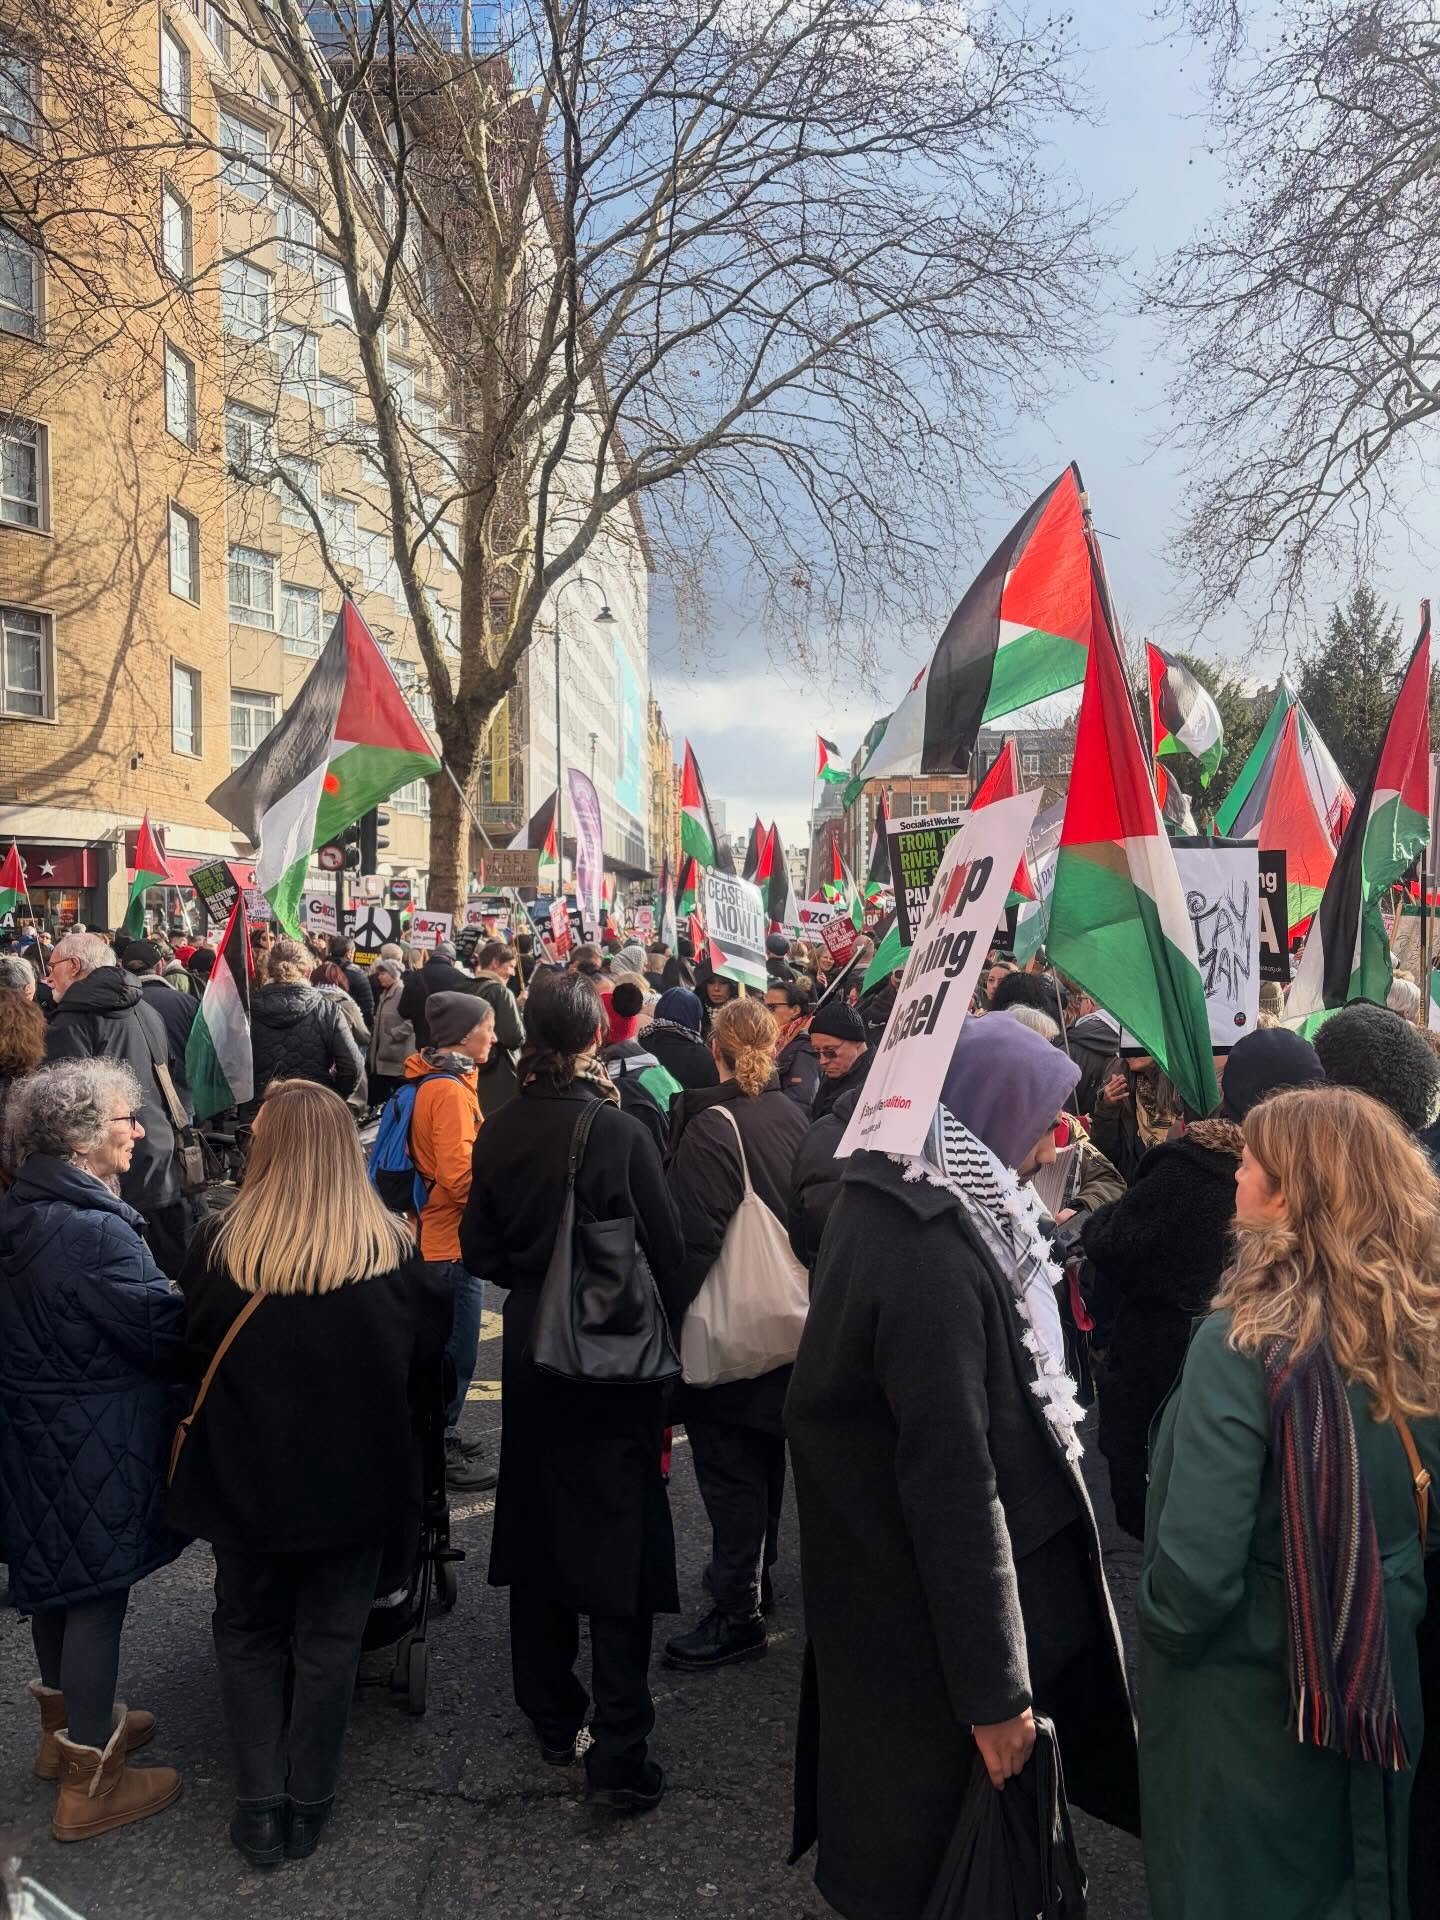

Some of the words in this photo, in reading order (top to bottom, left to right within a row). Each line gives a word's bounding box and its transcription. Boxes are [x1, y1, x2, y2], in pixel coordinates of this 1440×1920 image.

[900, 818, 933, 831] Socialist
[933, 815, 961, 826] Worker
[898, 831, 937, 852] FROM
[493, 852, 529, 864] FREE
[900, 849, 939, 871] RIVER
[902, 870, 929, 888] THE
[205, 885, 236, 905] PALESTINE
[925, 855, 994, 930] Sp
[209, 900, 223, 912] WILL
[223, 896, 233, 906] BE
[309, 900, 335, 918] Gza
[0, 912, 15, 927] A
[213, 908, 229, 920] FREE
[714, 901, 759, 943] NOW!
[413, 917, 447, 933] Gza
